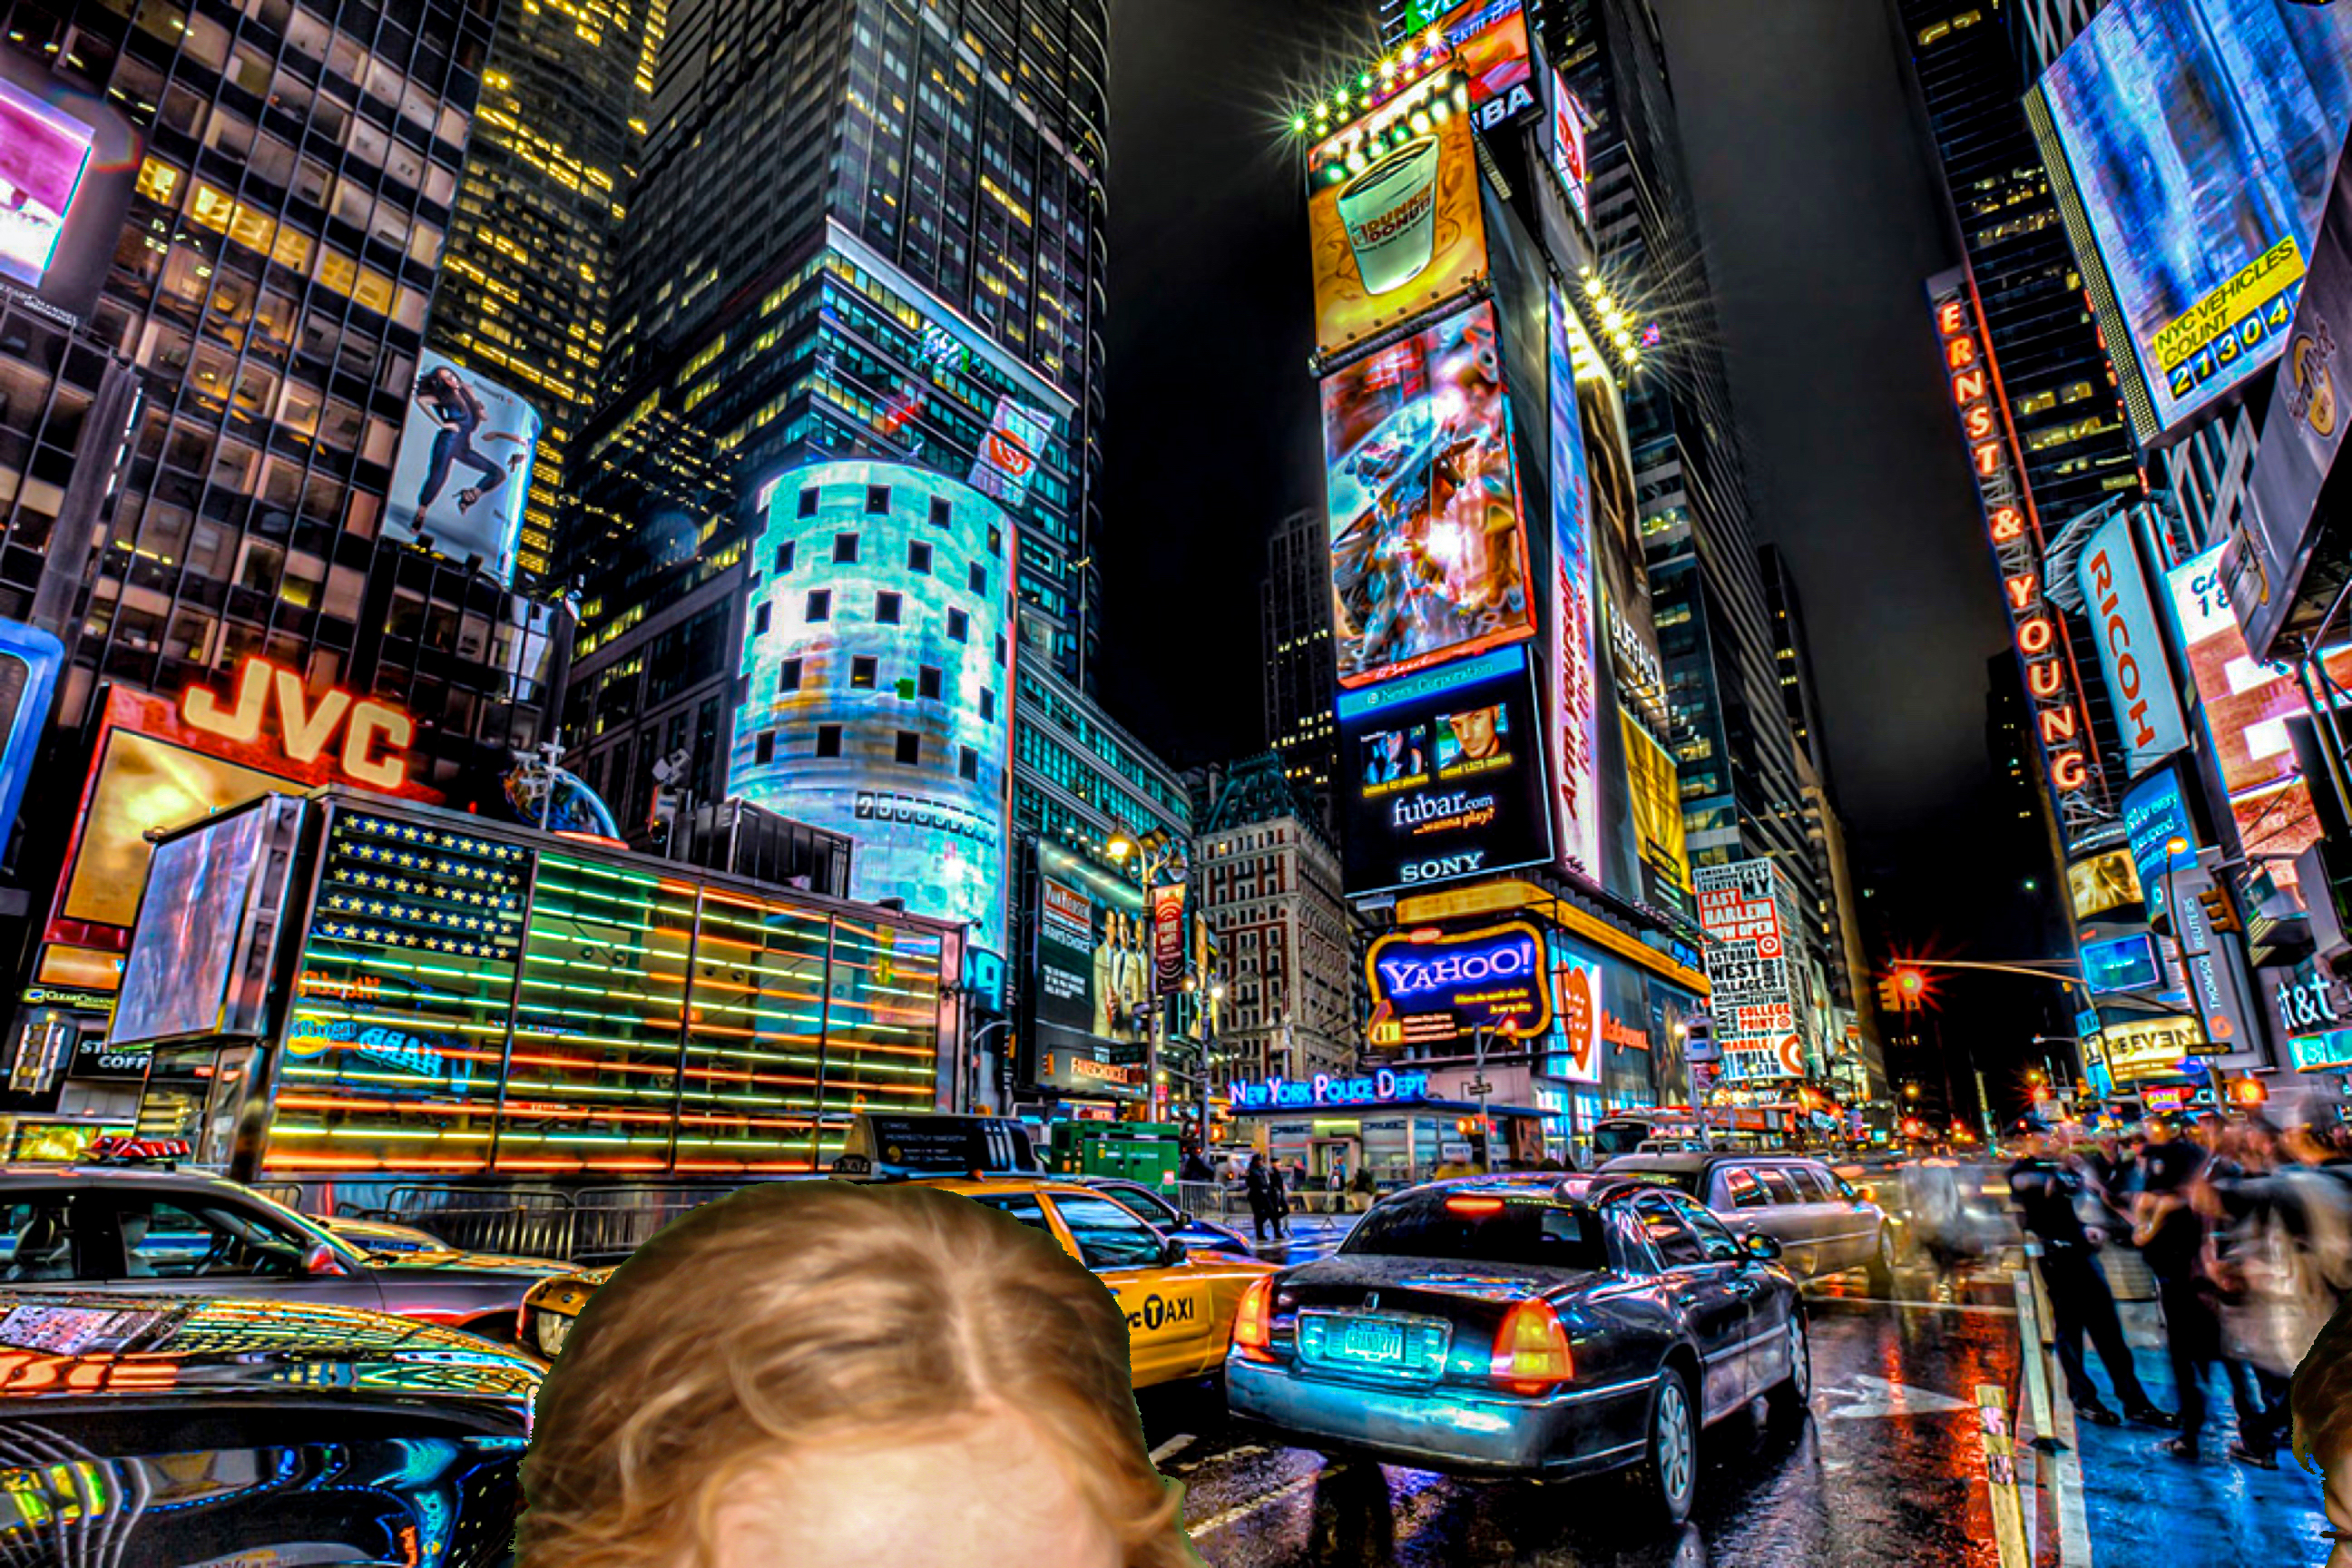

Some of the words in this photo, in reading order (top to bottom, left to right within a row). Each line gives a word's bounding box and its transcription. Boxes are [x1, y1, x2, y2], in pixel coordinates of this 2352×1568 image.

[2158, 310, 2195, 350] NYC
[2196, 239, 2295, 319] VEHICLES
[2163, 307, 2230, 367] COUNT
[1938, 299, 2001, 475] ERNST
[1990, 505, 2024, 541] &
[1558, 555, 1579, 721] yourself
[2089, 549, 2155, 750] RICOH
[2004, 573, 2087, 791] YOUNG
[182, 657, 412, 789] JVC
[1559, 724, 1579, 819] Arm
[1400, 850, 1485, 883] SONY
[1742, 877, 1769, 897] NY
[1701, 890, 1737, 907] EAST
[1704, 902, 1773, 926] HARLEM
[1378, 941, 1534, 995] YAHOO!
[1710, 962, 1759, 981] WEST
[1230, 1079, 1268, 1105] NEW
[1267, 1077, 1312, 1103] YORK
[1314, 1074, 1373, 1102] POLICE
[1377, 1069, 1427, 1098] DEPT
[1145, 1294, 1195, 1330] TAXI
